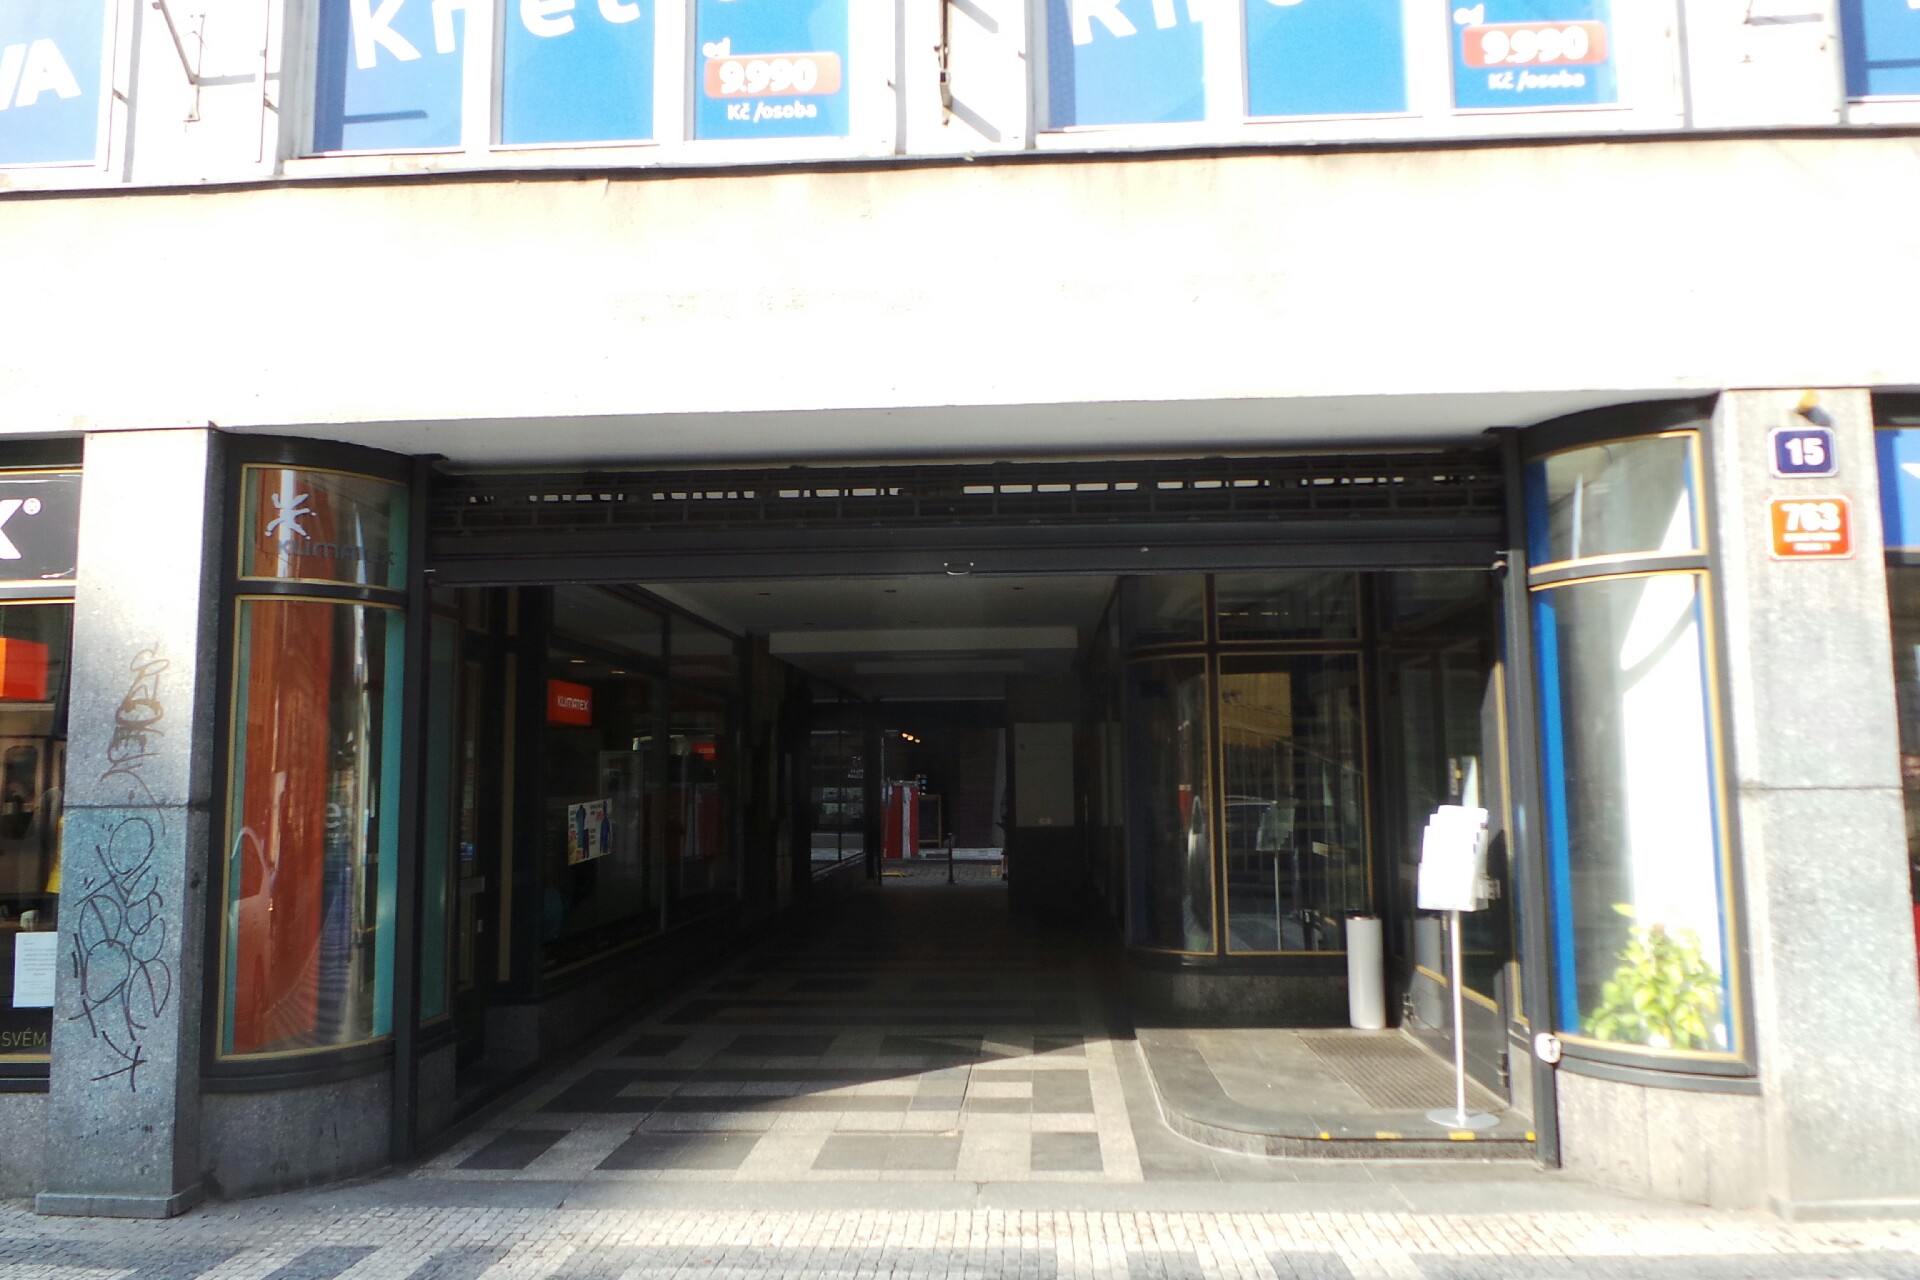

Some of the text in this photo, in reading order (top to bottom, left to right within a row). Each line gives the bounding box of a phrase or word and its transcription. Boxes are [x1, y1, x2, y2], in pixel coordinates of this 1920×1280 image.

[1453, 4, 1484, 25] od
[702, 37, 731, 58] od
[1481, 25, 1589, 64] 9.990
[718, 58, 818, 94] 9.990
[727, 100, 817, 123] Kč /osoba
[1785, 437, 1826, 466] 15
[1, 1027, 47, 1047] SVÉM
